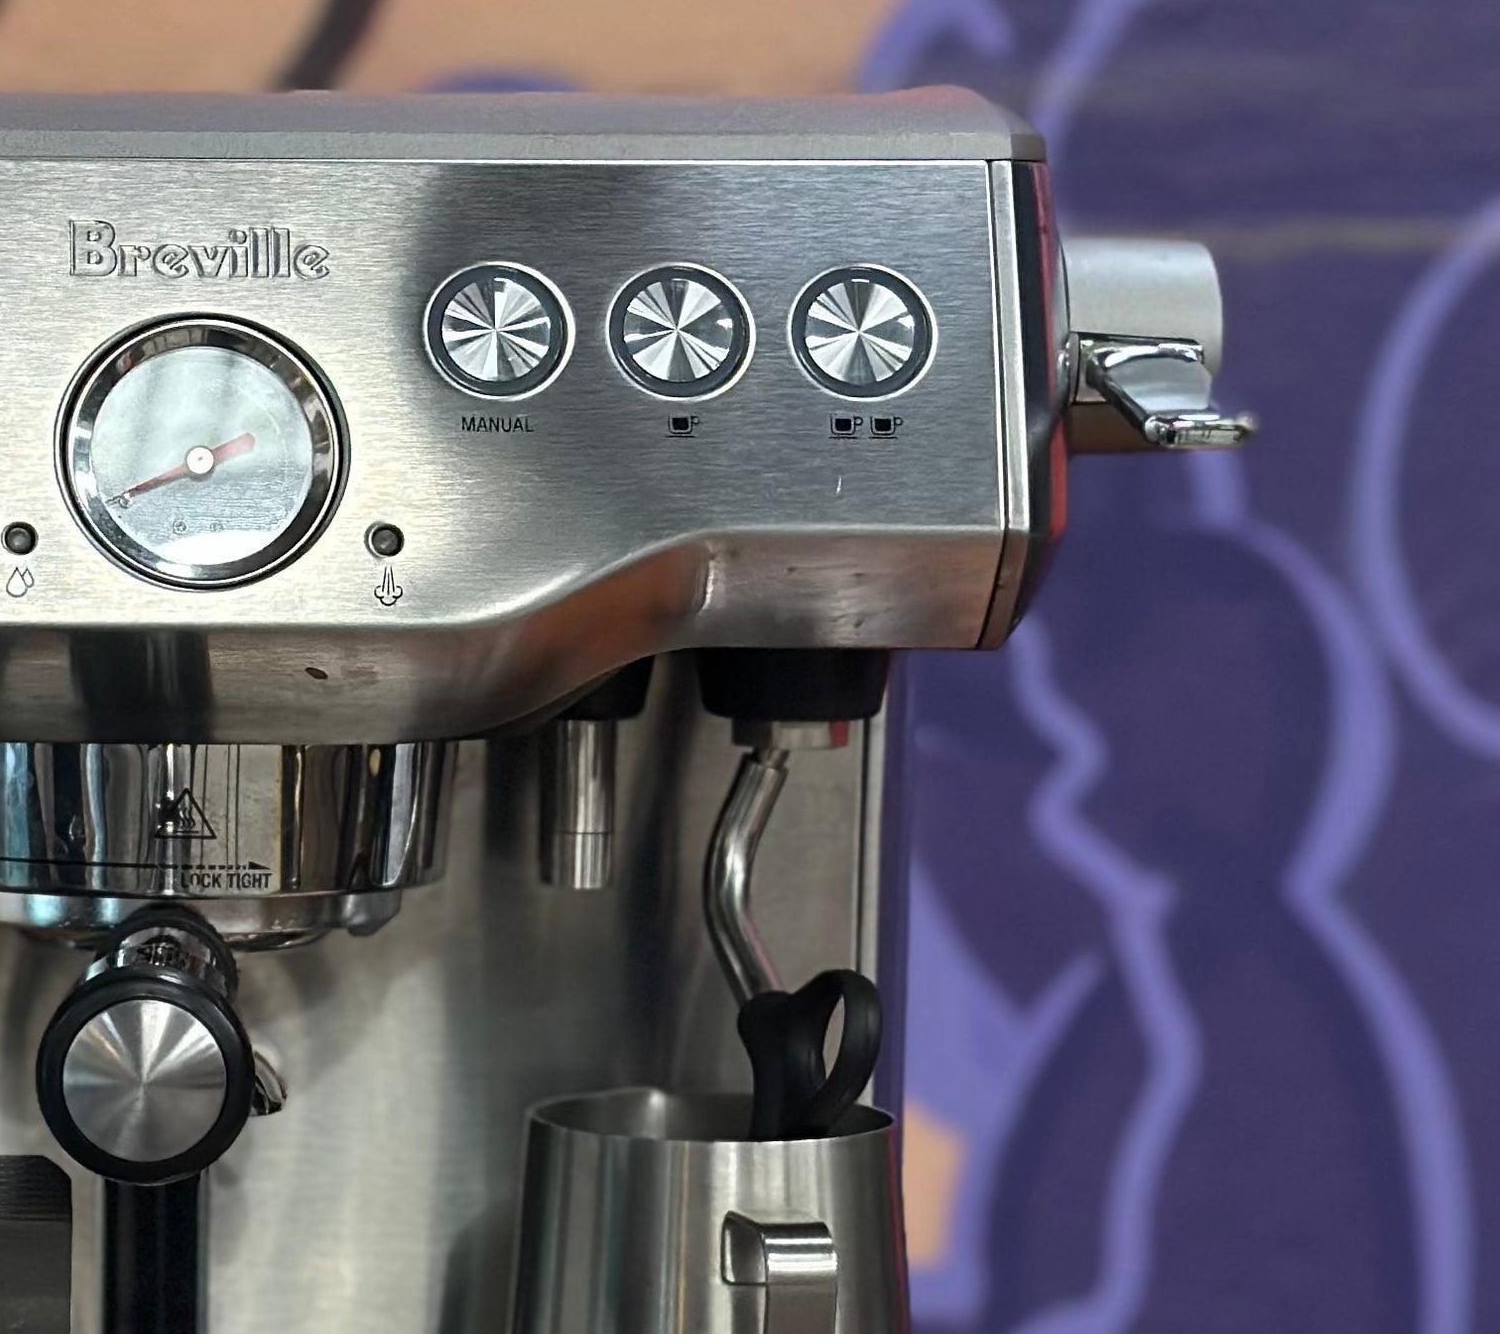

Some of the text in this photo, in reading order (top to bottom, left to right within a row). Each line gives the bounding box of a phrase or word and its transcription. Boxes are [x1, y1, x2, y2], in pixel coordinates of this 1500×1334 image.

[68, 219, 331, 280] Breville
[461, 415, 535, 433] MANUAL
[180, 872, 273, 890] LOCK TIGHT
